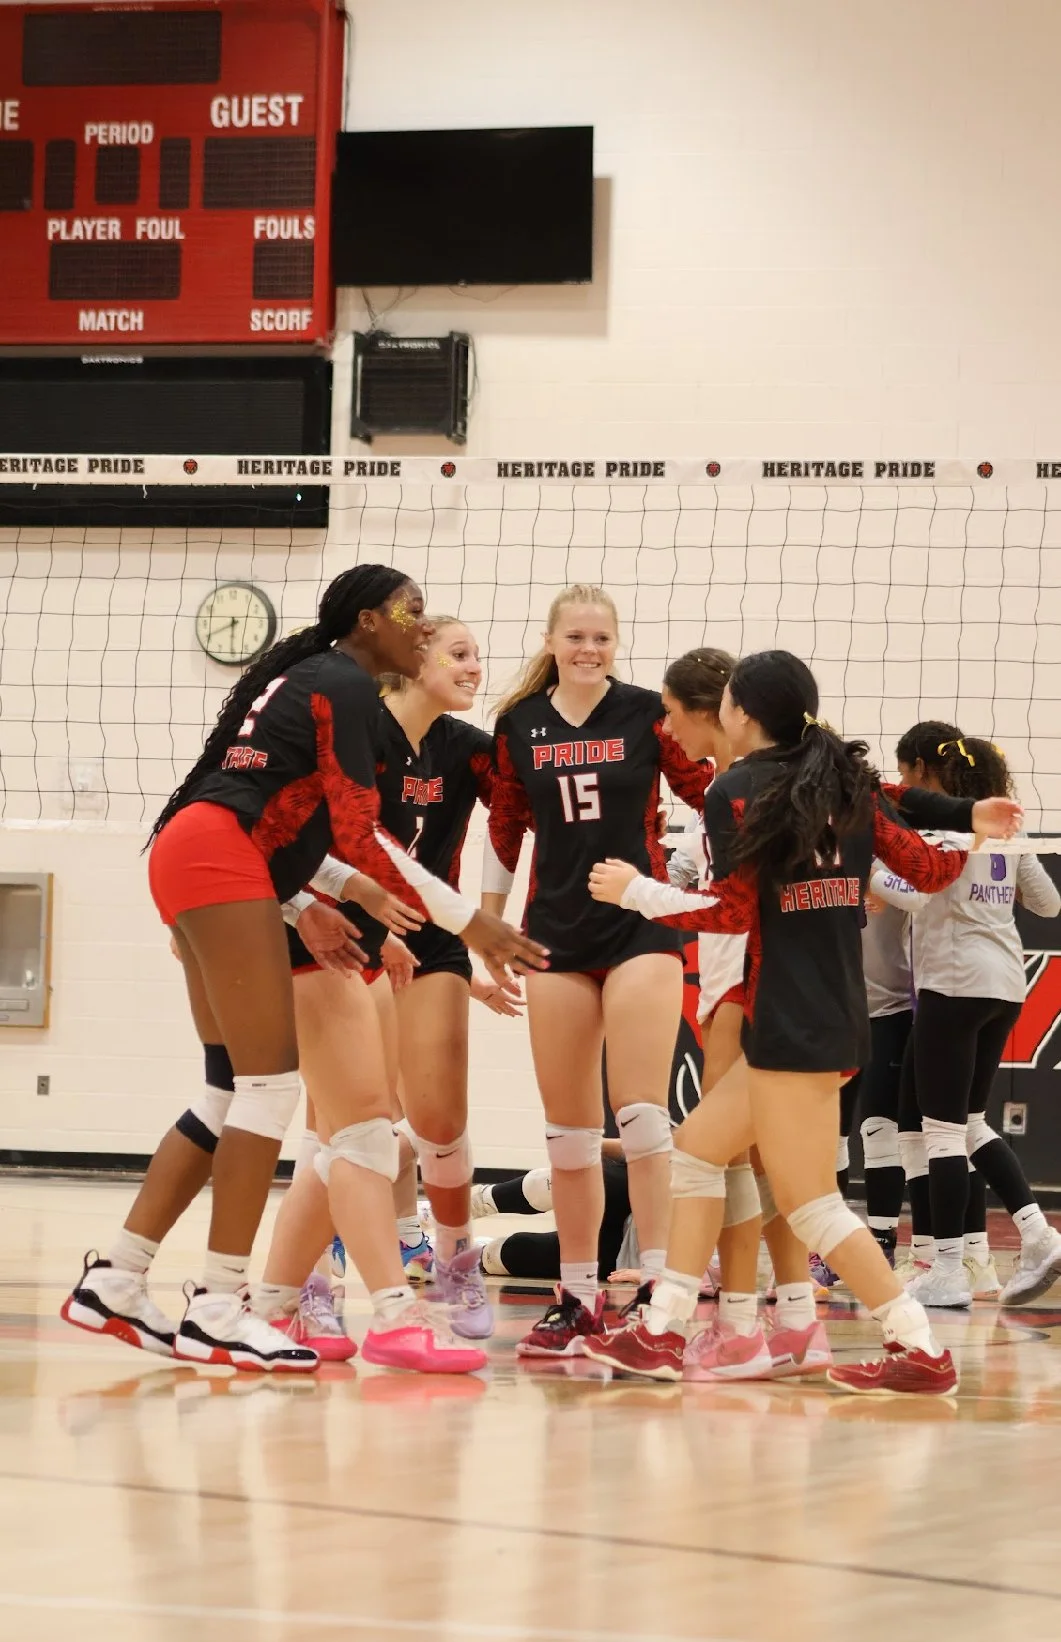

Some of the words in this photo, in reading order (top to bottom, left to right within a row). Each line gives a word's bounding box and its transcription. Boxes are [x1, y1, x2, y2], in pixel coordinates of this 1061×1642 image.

[0, 99, 20, 131] E
[210, 94, 304, 129] GUEST
[84, 122, 155, 145] PERIOD
[47, 217, 122, 241] PLAYER
[135, 217, 186, 240] FOUL
[253, 215, 315, 240] FOULS
[78, 309, 145, 332] MATCH
[0, 457, 79, 473] ERITAGE
[87, 457, 145, 474] PRIDE
[236, 459, 333, 475] HERITAGE
[343, 460, 401, 477] PRIDE
[496, 461, 596, 478] HERITAGE
[605, 461, 666, 478] PRIDE
[761, 461, 865, 478] HERITAGE
[874, 461, 936, 478] PRIDE
[531, 738, 625, 770] PRIDE
[557, 772, 602, 823] 15
